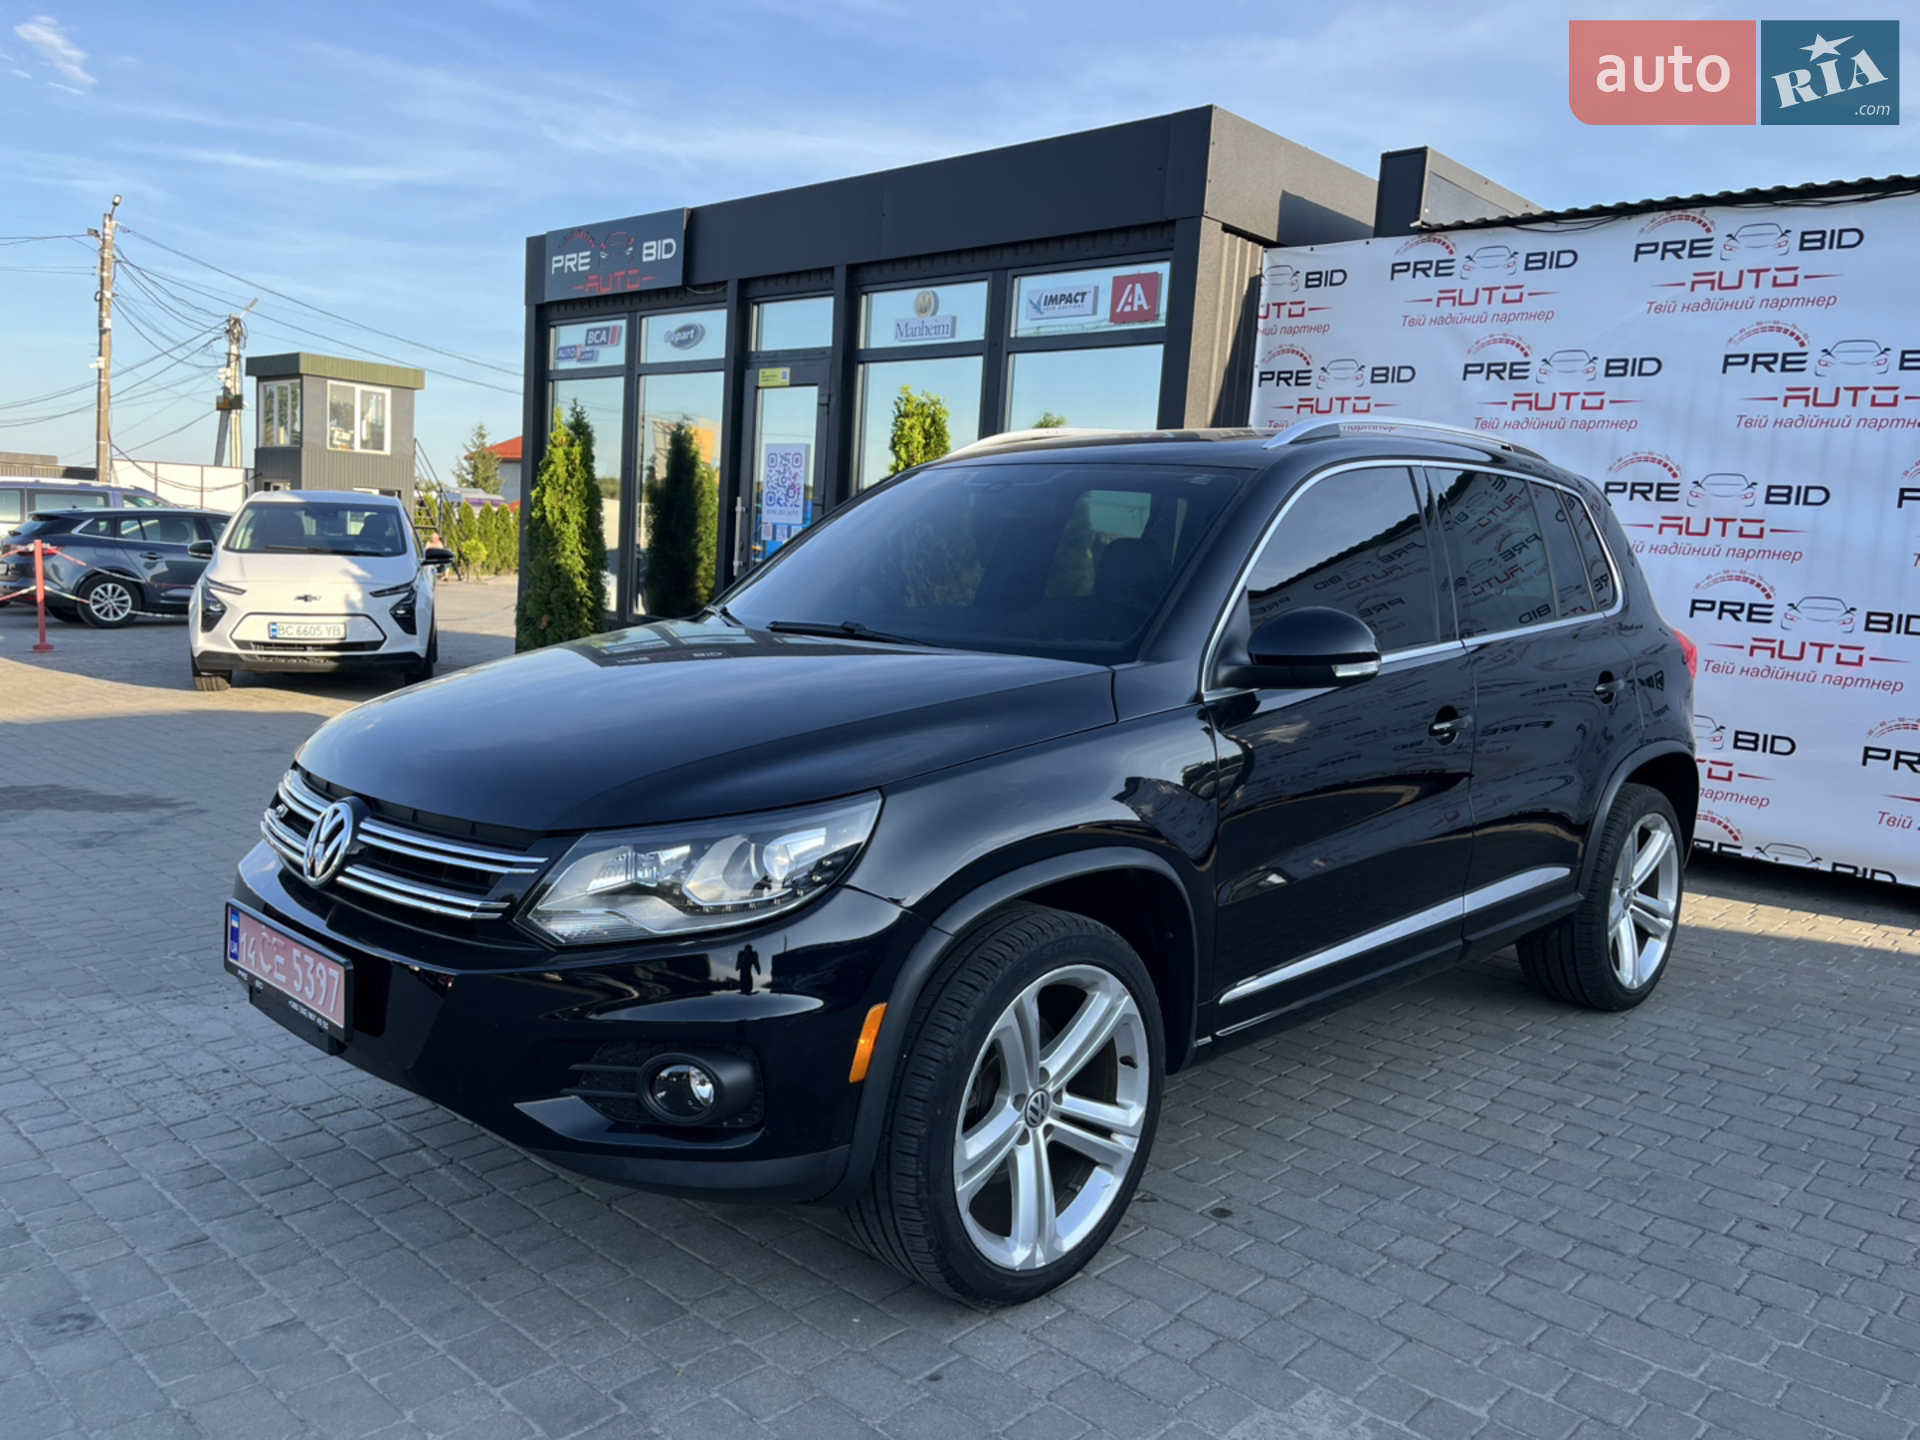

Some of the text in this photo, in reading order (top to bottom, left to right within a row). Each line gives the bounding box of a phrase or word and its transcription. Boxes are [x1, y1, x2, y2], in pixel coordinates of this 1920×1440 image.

[1633, 228, 1865, 262] PRE BID
[551, 238, 677, 275] PRE BID
[1390, 249, 1578, 280] PRE BID
[585, 269, 640, 294] AUTO
[1304, 269, 1347, 288] BID
[1690, 266, 1800, 292] AUTO
[1043, 291, 1087, 306] IMPACT
[1436, 284, 1525, 307] AUTO
[1645, 294, 1838, 315] Твій надійний партнер
[1258, 301, 1306, 319] UTO
[1401, 309, 1555, 327] Твій надійний партнер
[587, 330, 607, 344] BCA
[894, 320, 950, 339] Manheim
[1279, 323, 1331, 337] партнер
[1462, 357, 1663, 381] PRE BID
[1722, 351, 1809, 374] PRE
[1258, 365, 1416, 387] PRE BID
[1296, 396, 1372, 415] AUTO
[1511, 391, 1606, 412] AUTO
[1783, 385, 1900, 408] AUTO
[1473, 416, 1639, 432] Твій надійний партнер
[1735, 413, 1920, 432] Твій надійний партн
[1603, 481, 1831, 507] PRE BID
[1658, 515, 1765, 539] AUTO
[1648, 542, 1722, 558] надійний
[1725, 547, 1803, 564] партнер
[1689, 599, 1775, 624] PRE
[278, 625, 342, 637] BC 6605 YB
[1749, 637, 1865, 667] AUTO
[1703, 659, 1904, 695] Твій надійний партнер
[1732, 730, 1796, 756] BID
[1861, 746, 1920, 774] PR
[1878, 811, 1913, 829] Твій
